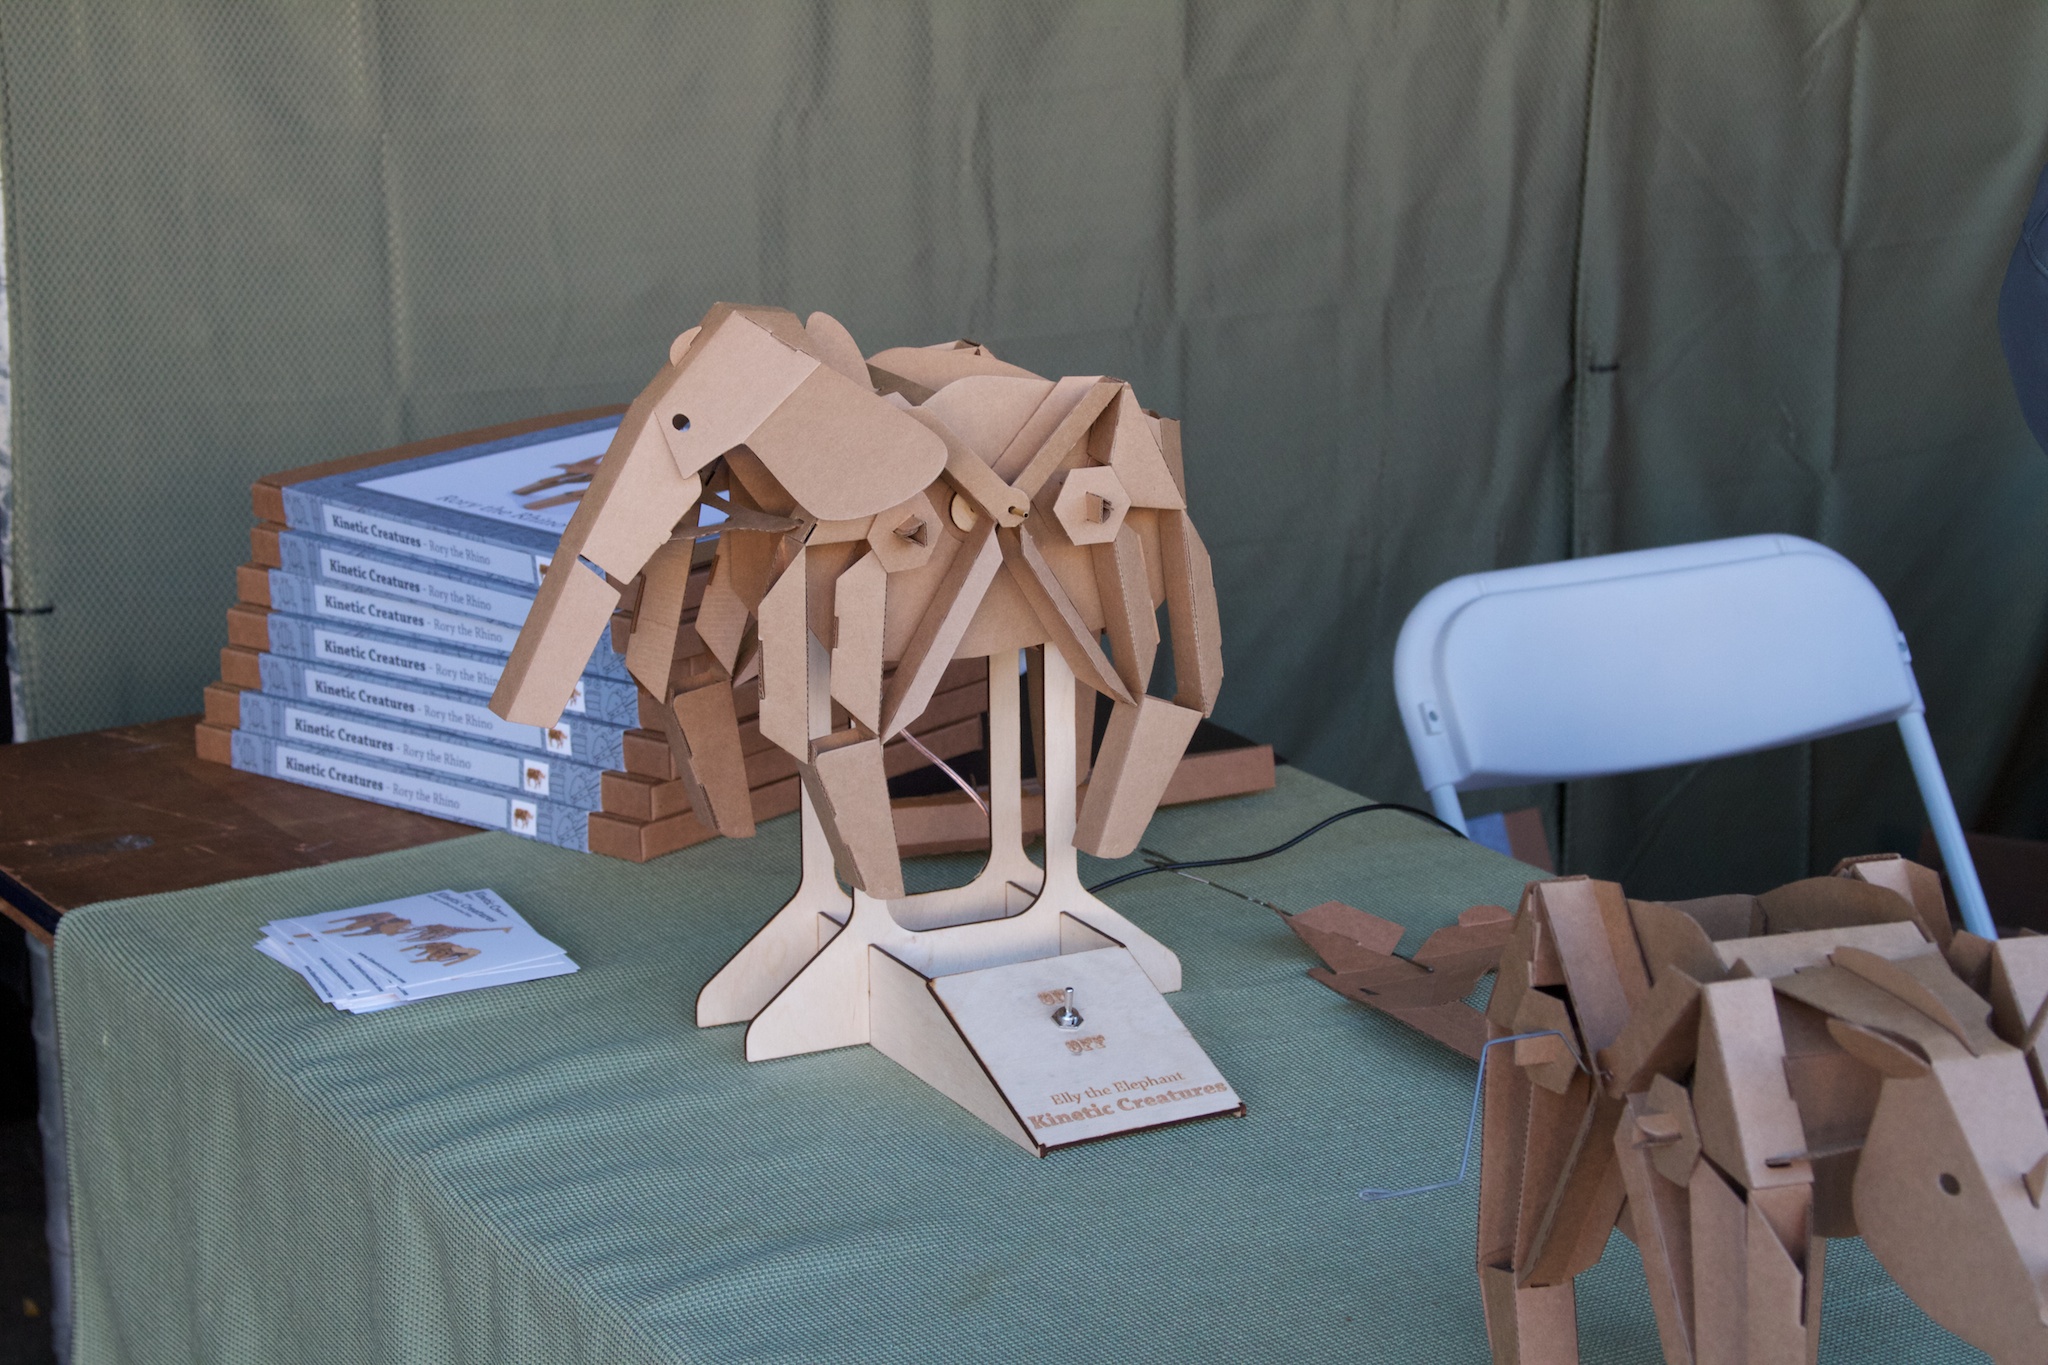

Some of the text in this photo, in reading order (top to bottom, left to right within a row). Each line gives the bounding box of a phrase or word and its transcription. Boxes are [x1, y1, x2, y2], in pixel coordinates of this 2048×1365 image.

[332, 515, 490, 565] Kinetic Creatures Rory the Rhino
[330, 559, 491, 611] Kinetic Creatures Rory the Rhino
[325, 595, 503, 643] Kinetic Creatures Rory the Rhino
[324, 640, 498, 685] Kinetic Creatures Rory the Rhin
[315, 680, 493, 730] Kinetic Creatures Rory the Rhino
[294, 718, 471, 769] Kinetic Creatures Rory the Rhino
[285, 756, 460, 809] Kinetic Creatures Rory the Rhino
[1065, 1034, 1106, 1053] OFF
[1028, 1081, 1227, 1129] Kinetic Creatures
[1051, 1071, 1185, 1106] Elly the Elephant
